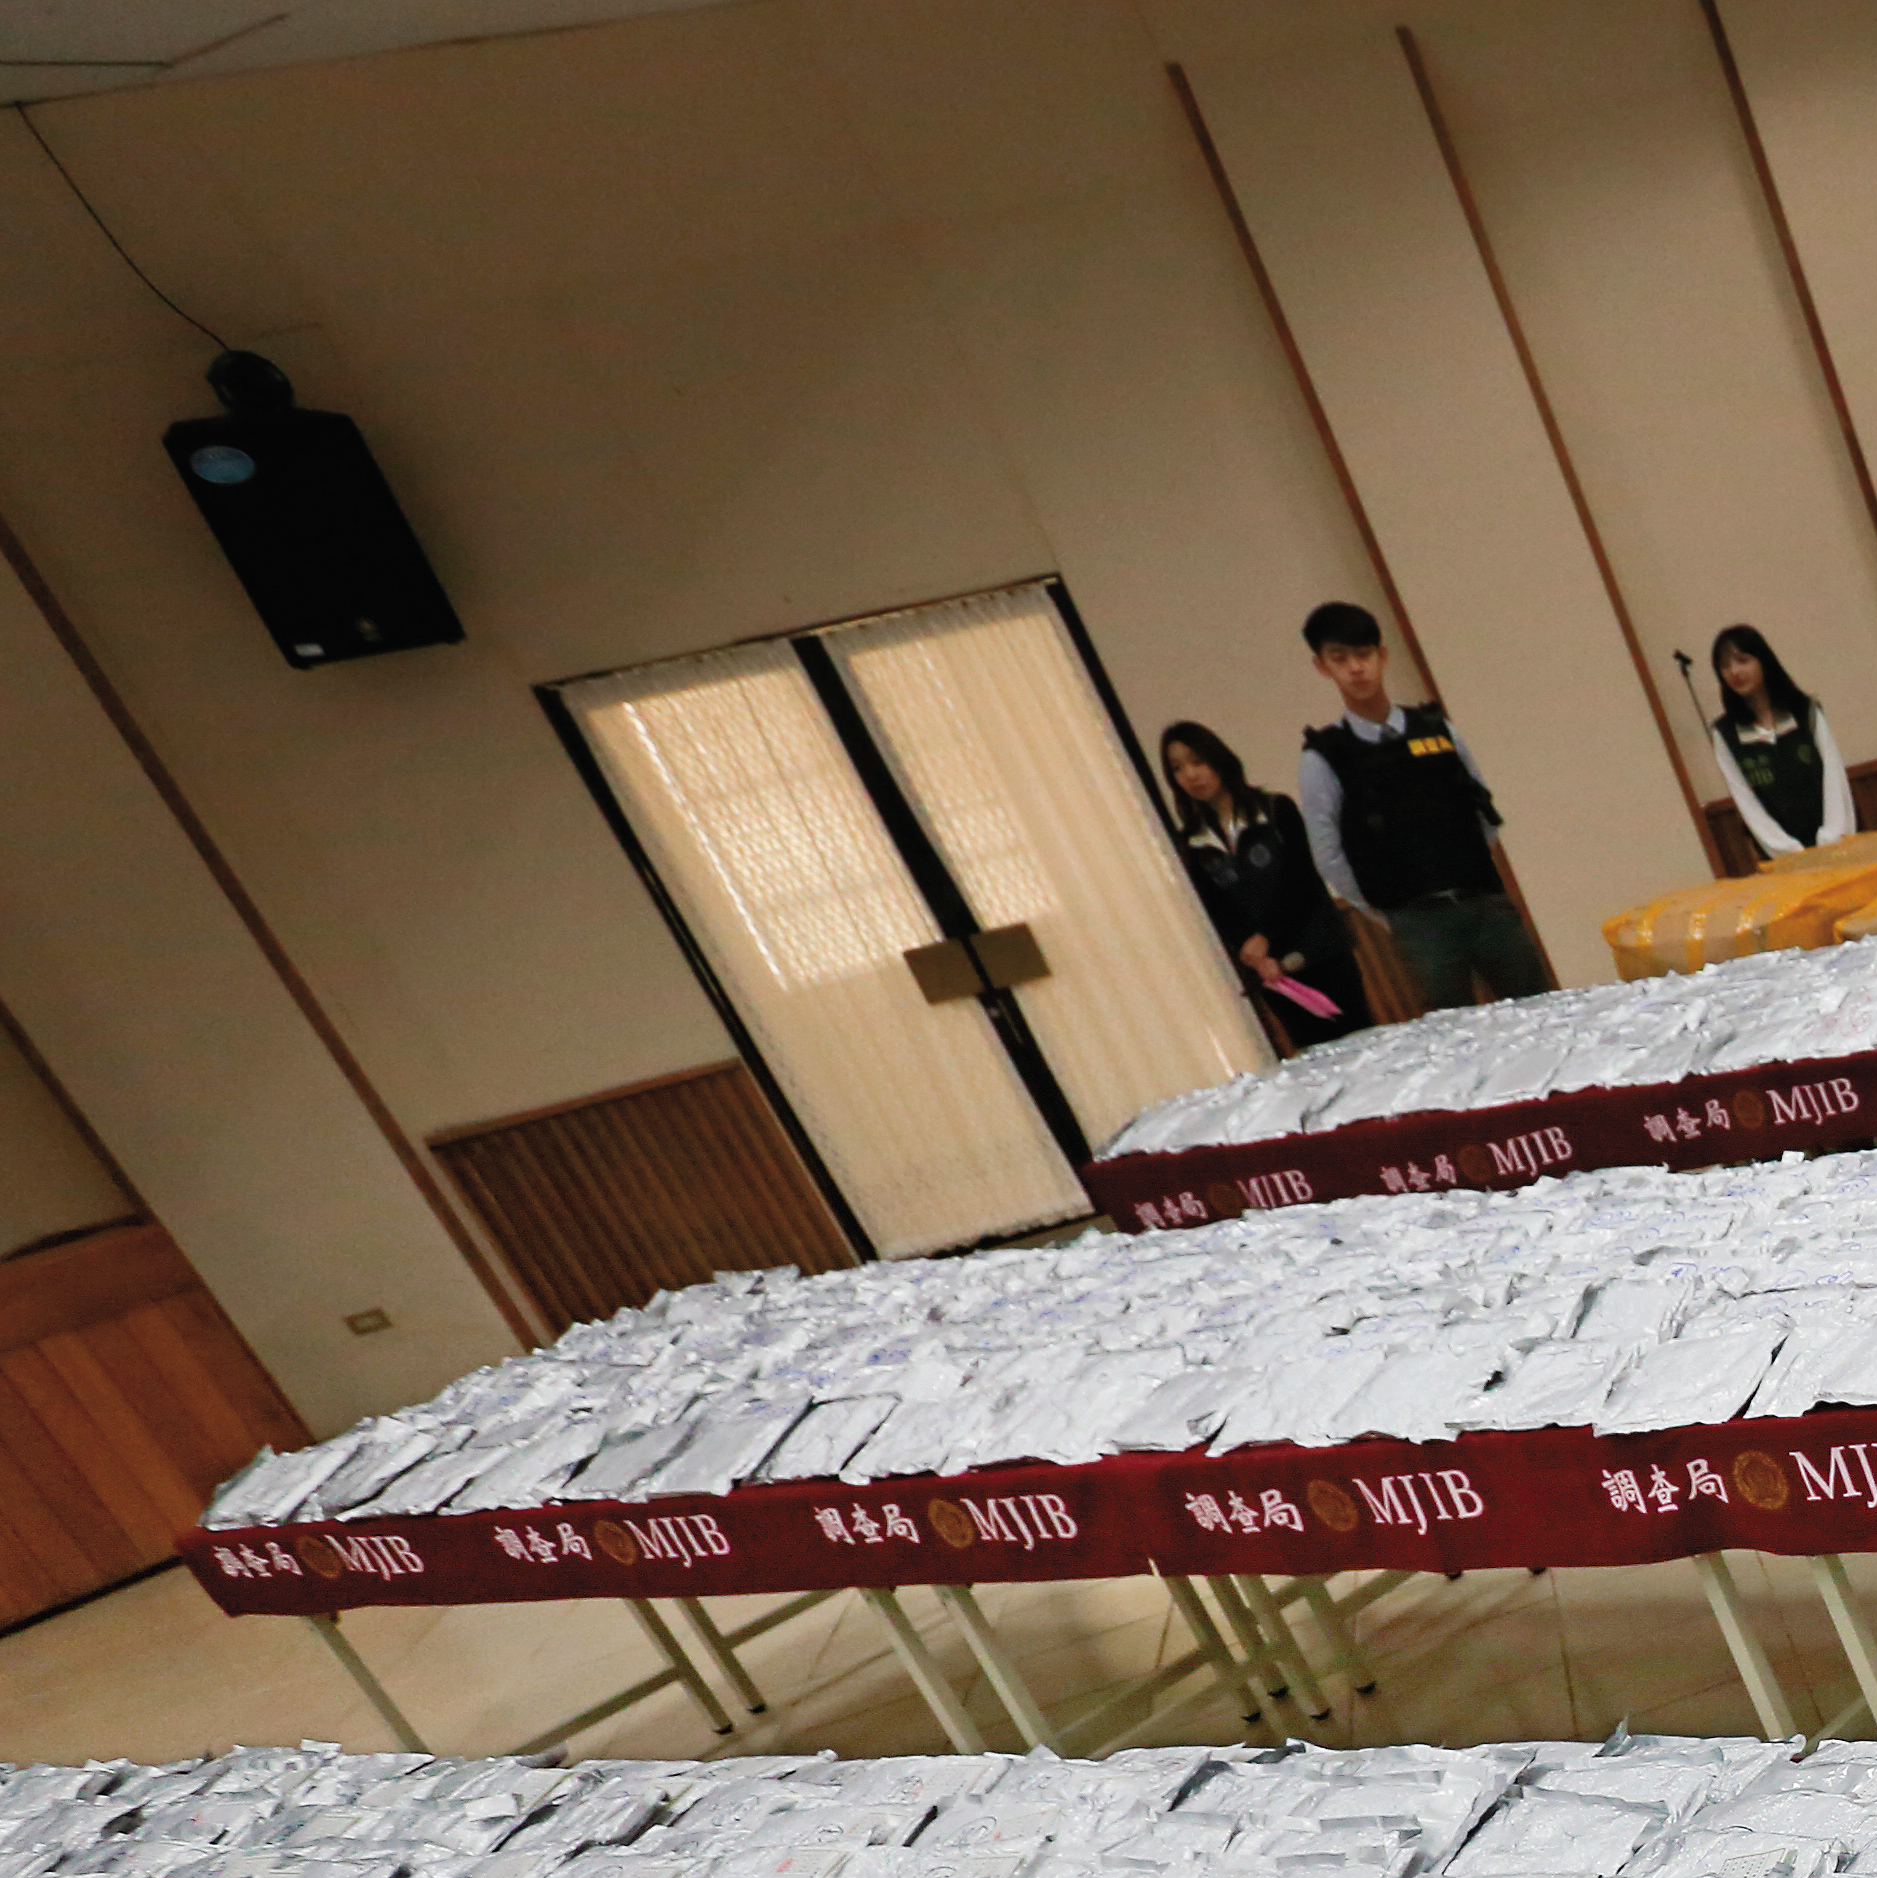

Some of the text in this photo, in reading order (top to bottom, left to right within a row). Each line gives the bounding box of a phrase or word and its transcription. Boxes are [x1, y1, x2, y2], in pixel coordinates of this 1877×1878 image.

[1644, 1098, 1731, 1143] 調查局
[1766, 1078, 1860, 1126] MJIB
[1353, 1470, 1484, 1536] MJIB
[1602, 1458, 1729, 1514] 調查局
[814, 1502, 920, 1545] 調查局
[961, 1494, 1078, 1549] MJIB
[1185, 1488, 1304, 1534] 調查局
[213, 1542, 301, 1578] 調查局
[323, 1535, 425, 1581] MJIB
[494, 1522, 593, 1564] 調查局
[635, 1514, 731, 1569] MJIB
